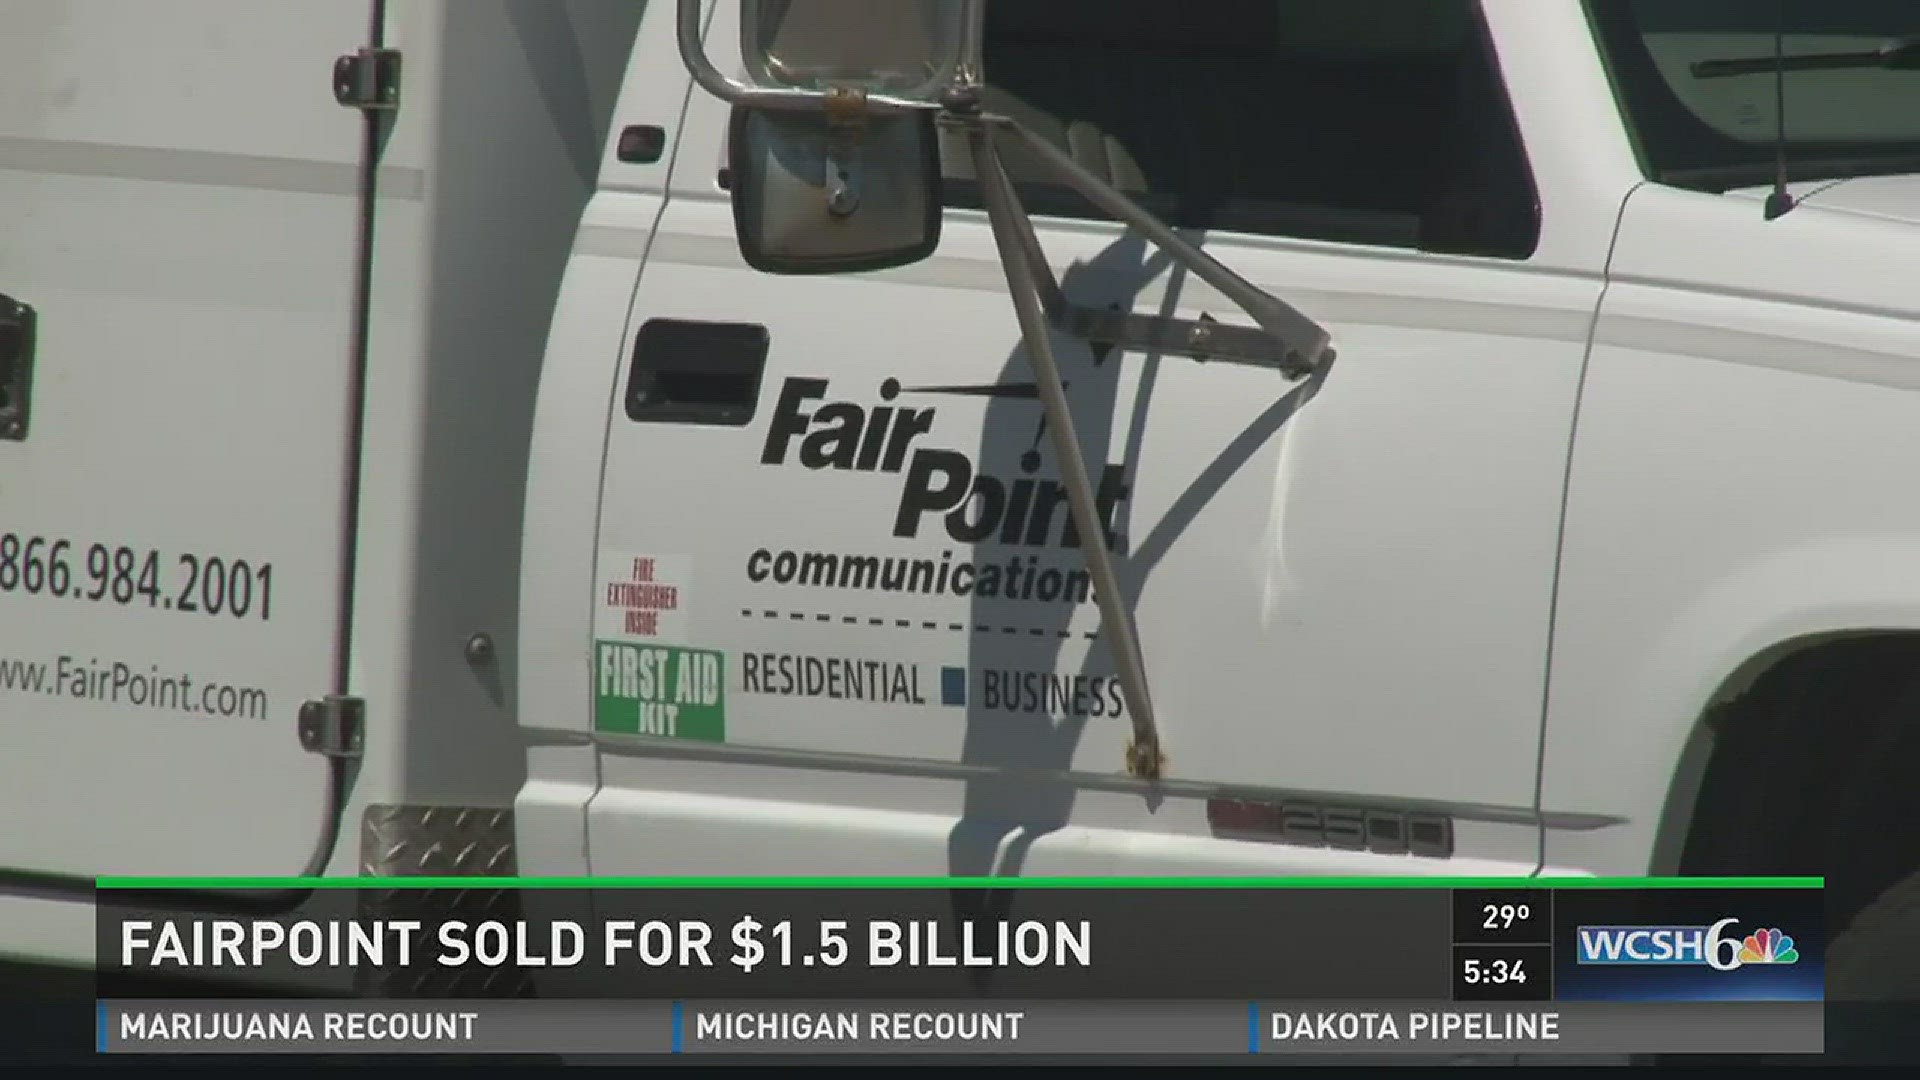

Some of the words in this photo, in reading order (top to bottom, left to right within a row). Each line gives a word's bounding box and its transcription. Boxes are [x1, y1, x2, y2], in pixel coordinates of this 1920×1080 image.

[761, 376, 936, 472] Fair
[893, 447, 1130, 553] Point
[0, 532, 273, 621] 866.984.2001
[607, 583, 678, 610] EXTINGUISHER
[633, 557, 655, 582] FIRE
[746, 547, 1099, 605] communication
[625, 611, 658, 636] INSIDE
[600, 645, 669, 700] FIRST
[675, 651, 719, 706] AID
[742, 652, 926, 706] RESIDENTIAL
[983, 669, 1123, 719] BUSINESS
[638, 701, 680, 737] KIT
[1283, 802, 1453, 858] 2500
